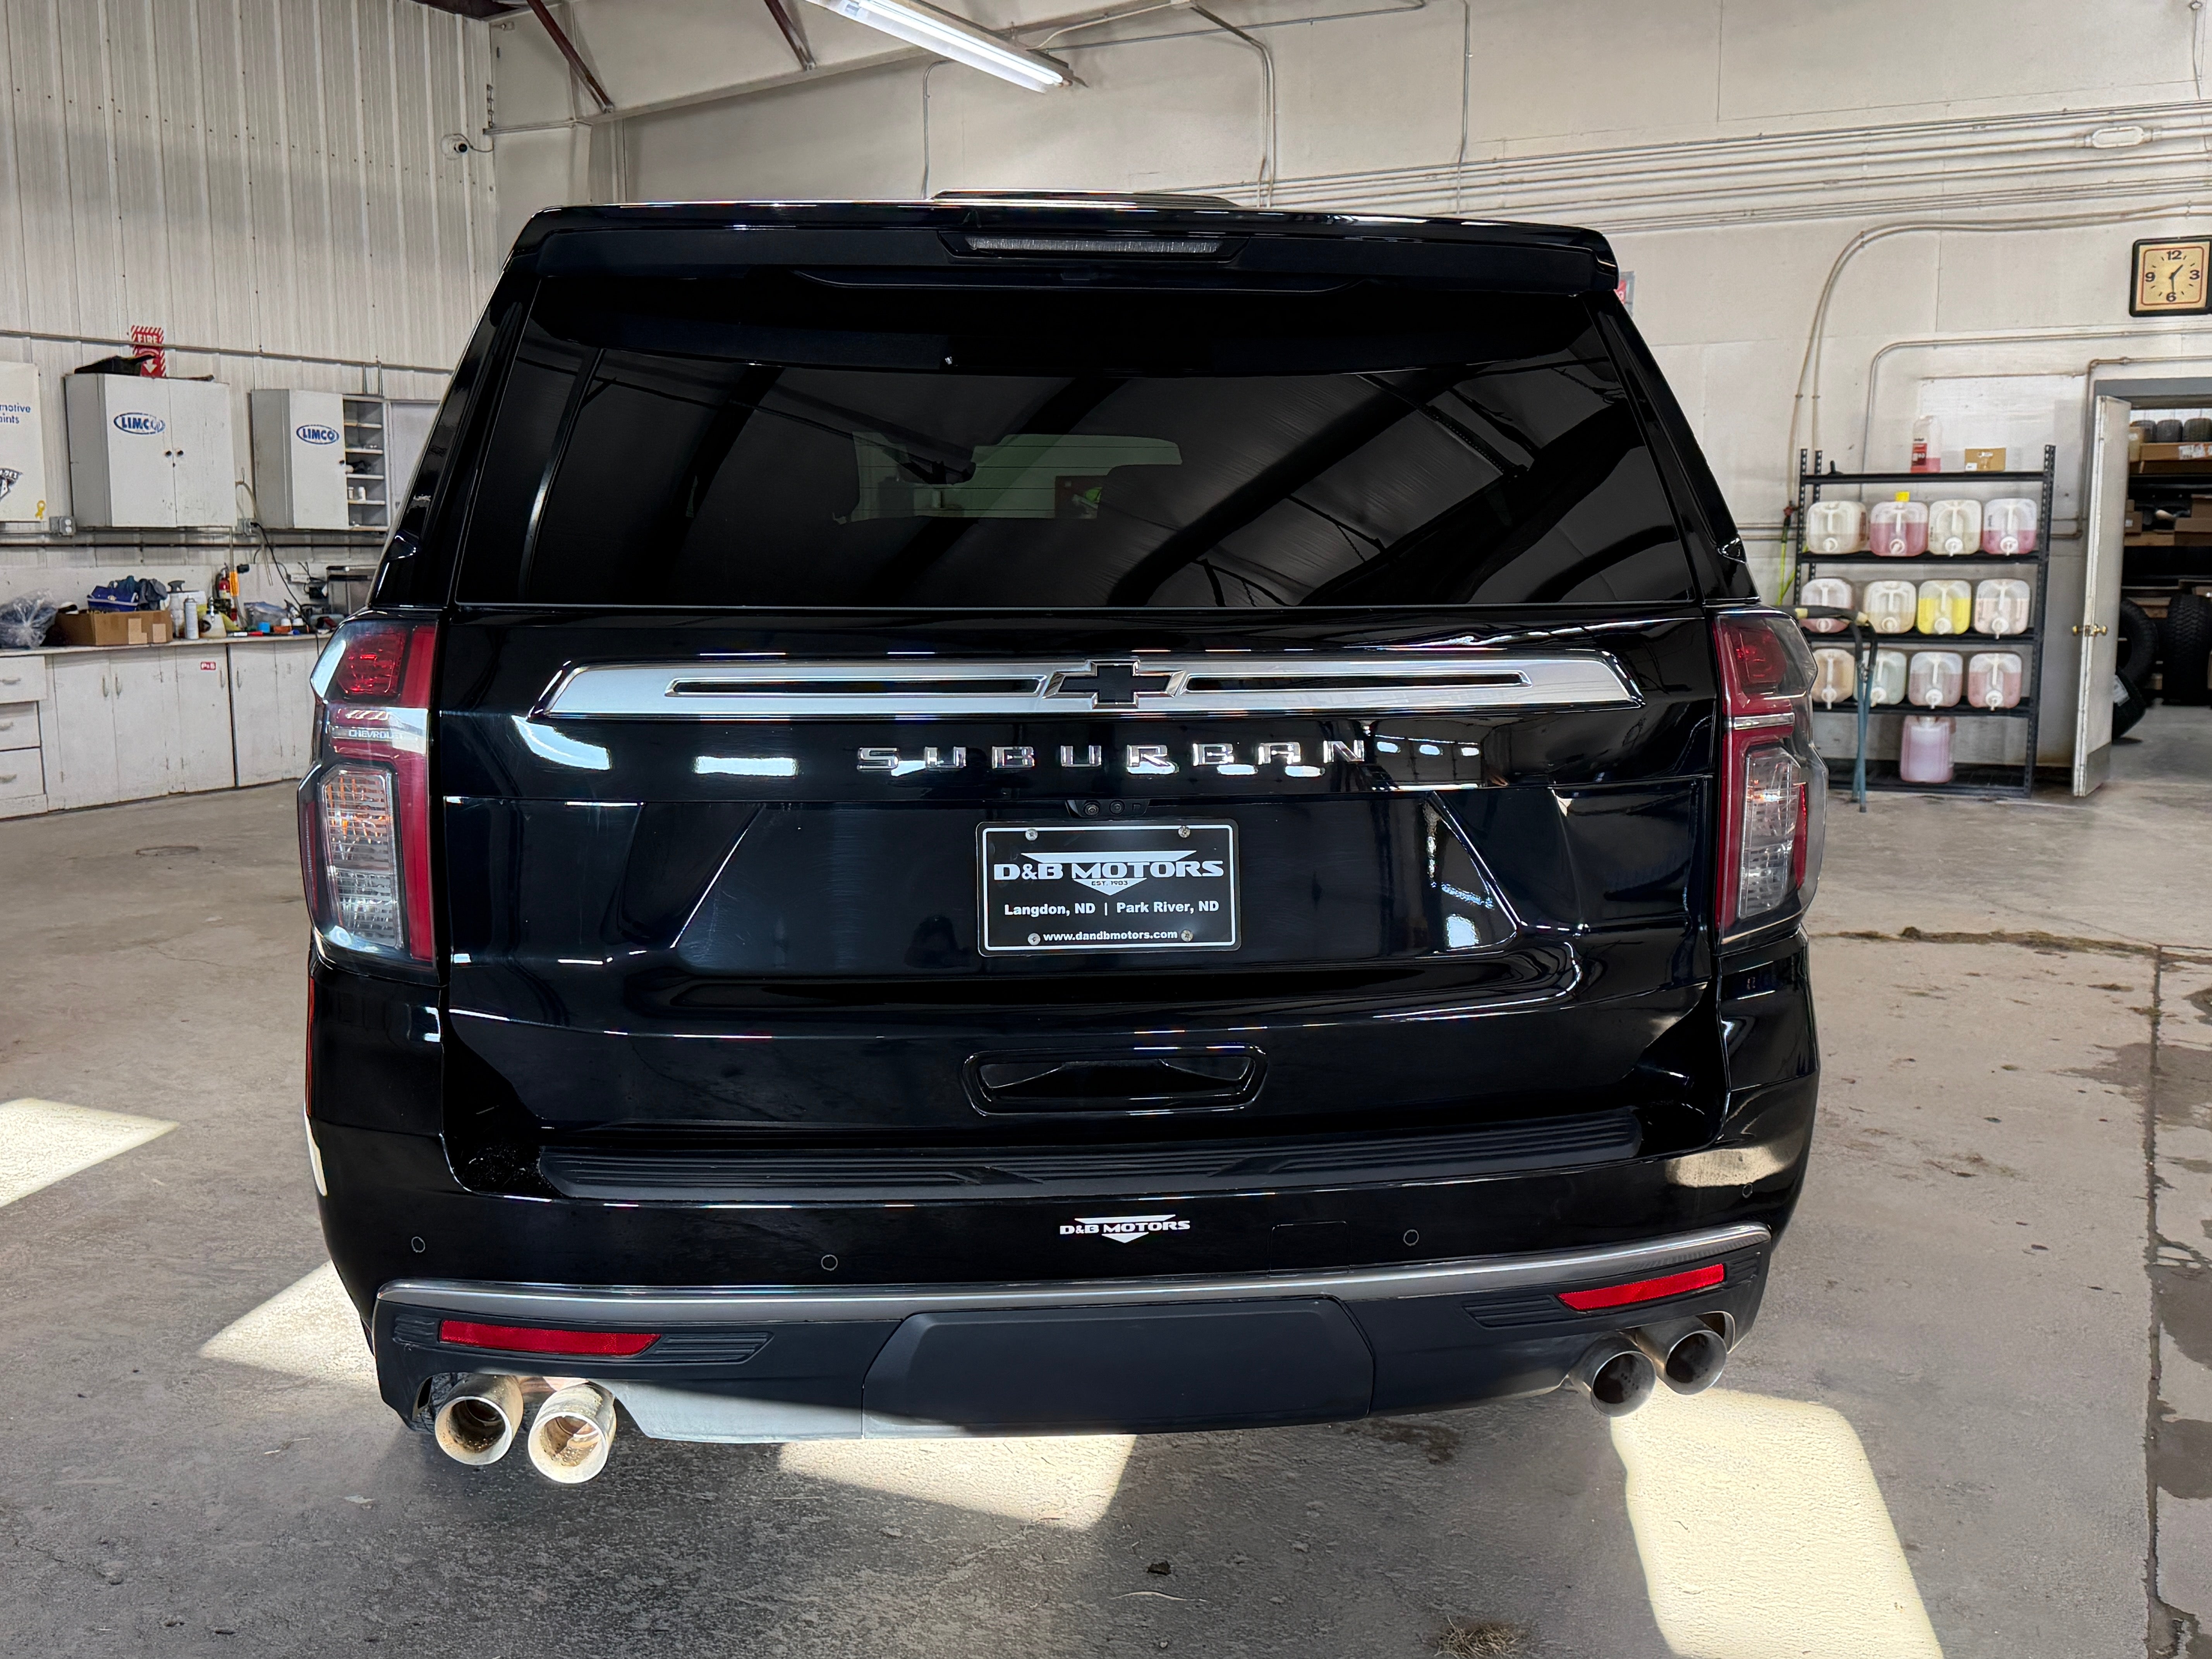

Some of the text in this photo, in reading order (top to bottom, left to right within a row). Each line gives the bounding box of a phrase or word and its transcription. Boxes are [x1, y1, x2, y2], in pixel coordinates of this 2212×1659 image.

[2167, 250, 2182, 260] 12
[2145, 270, 2200, 282] 9 3
[2166, 292, 2177, 302] 6
[137, 334, 158, 343] FIRE
[122, 417, 160, 430] LIMCO
[302, 428, 335, 441] LIMCO
[857, 740, 1364, 770] SUBURBAN
[994, 860, 1223, 881] D&B MOTORS
[1005, 904, 1070, 917] Langdon,
[1075, 903, 1096, 914] ND
[1117, 902, 1149, 913] Park
[1153, 901, 1194, 914] River,
[1199, 900, 1219, 912] ND
[1043, 930, 1178, 941] www.dandbmotors.com
[1060, 1220, 1190, 1235] D&B MOTORS
